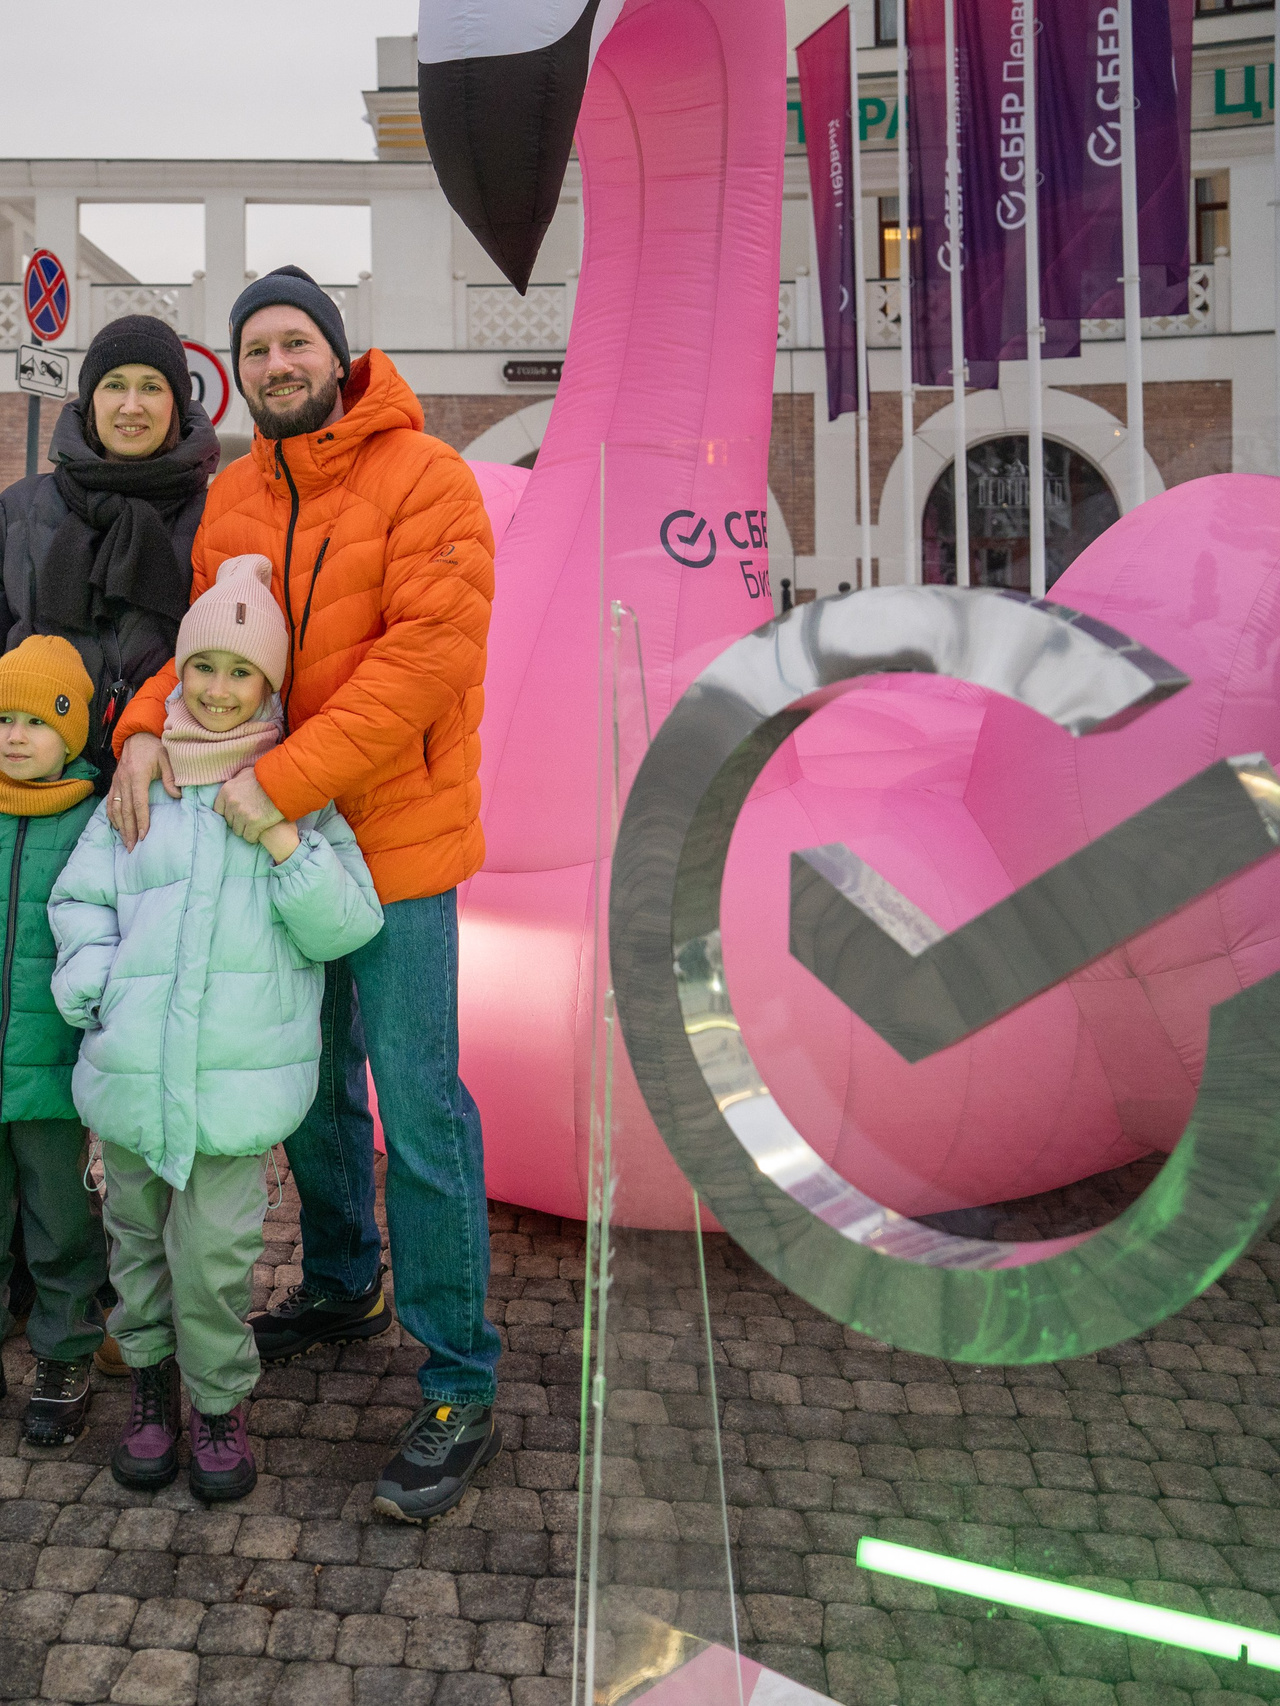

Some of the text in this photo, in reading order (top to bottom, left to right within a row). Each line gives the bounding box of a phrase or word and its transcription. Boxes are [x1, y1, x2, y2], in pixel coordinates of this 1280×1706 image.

[1000, 0, 1024, 183] СБЕР Перв
[724, 510, 768, 549] СБЕ
